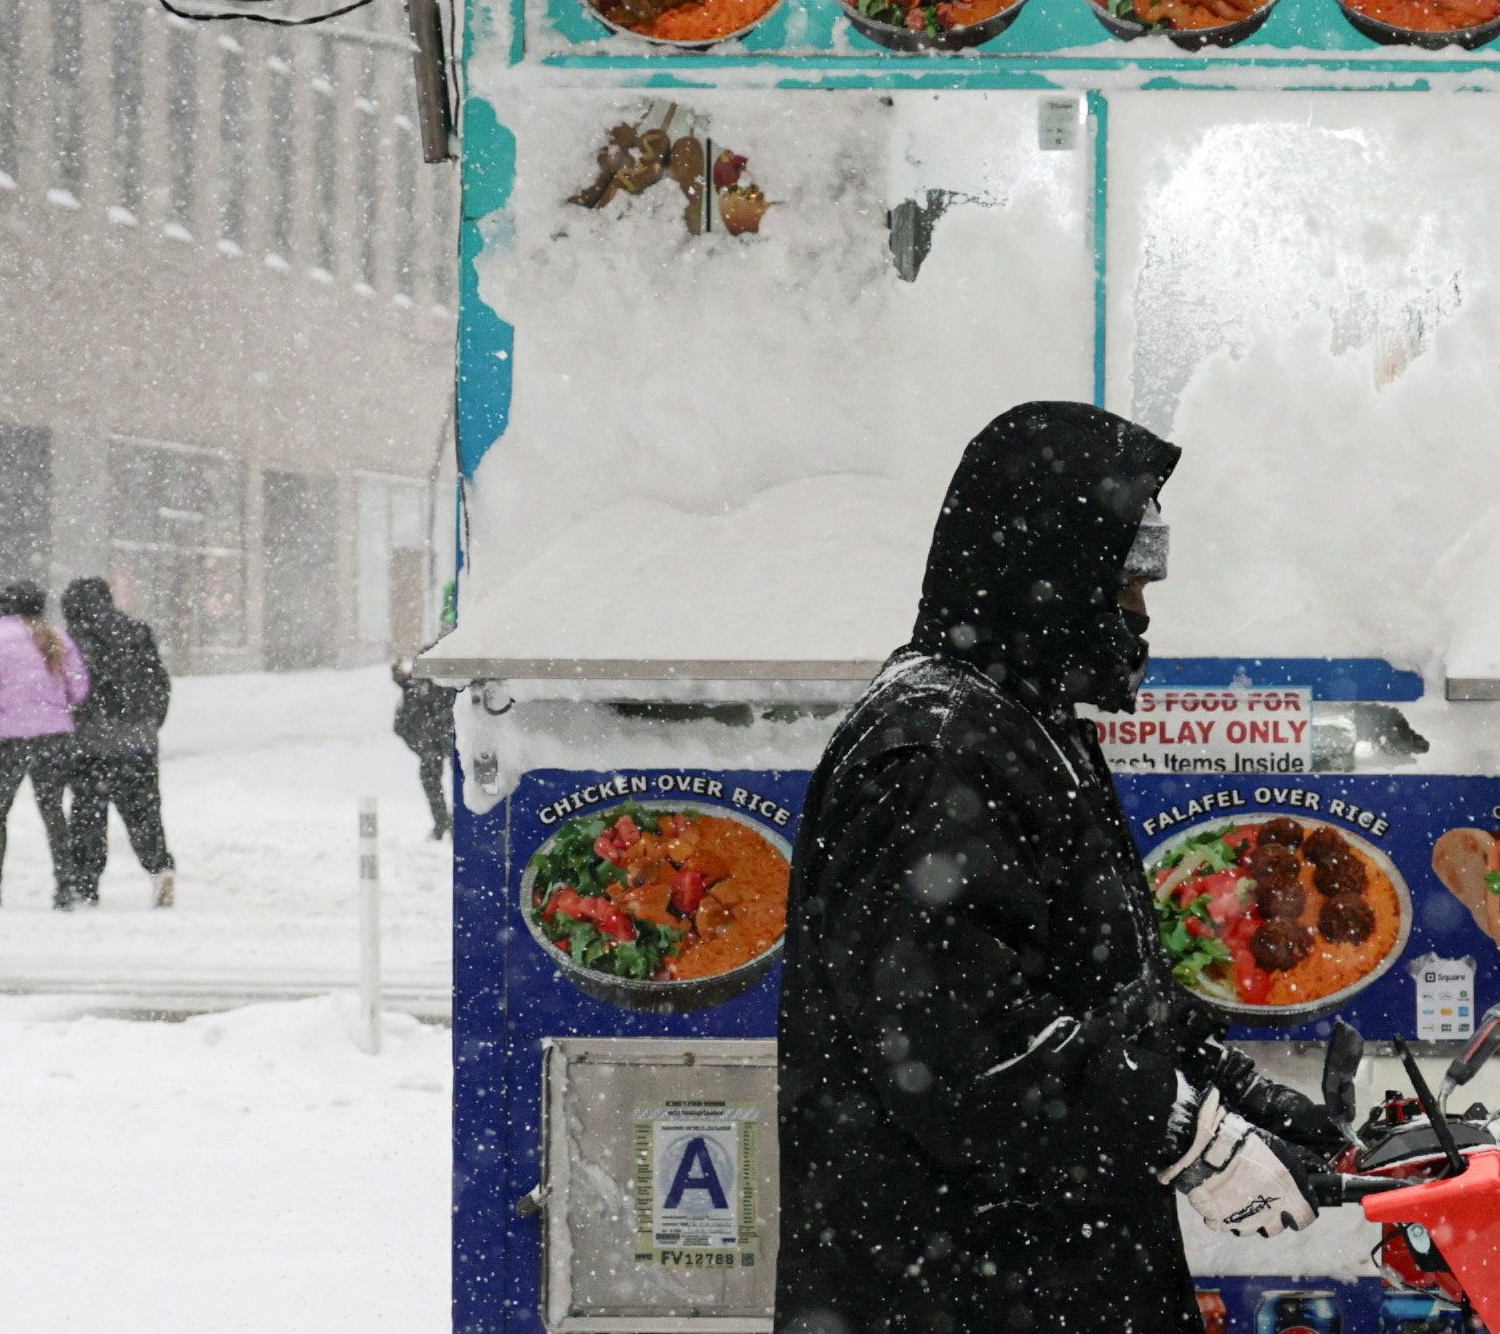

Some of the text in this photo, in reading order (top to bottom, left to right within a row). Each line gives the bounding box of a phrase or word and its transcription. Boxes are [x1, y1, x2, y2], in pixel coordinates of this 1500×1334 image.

[1164, 692, 1239, 713] FOOD
[1248, 692, 1302, 712] FOR
[1225, 720, 1309, 745] ONLY
[1164, 752, 1234, 773] Items
[1235, 752, 1305, 774] Inside
[537, 773, 793, 828] CHICKEN OVER RICE
[1142, 786, 1391, 839] FALAFEL OVER RICE
[663, 1137, 729, 1209] A
